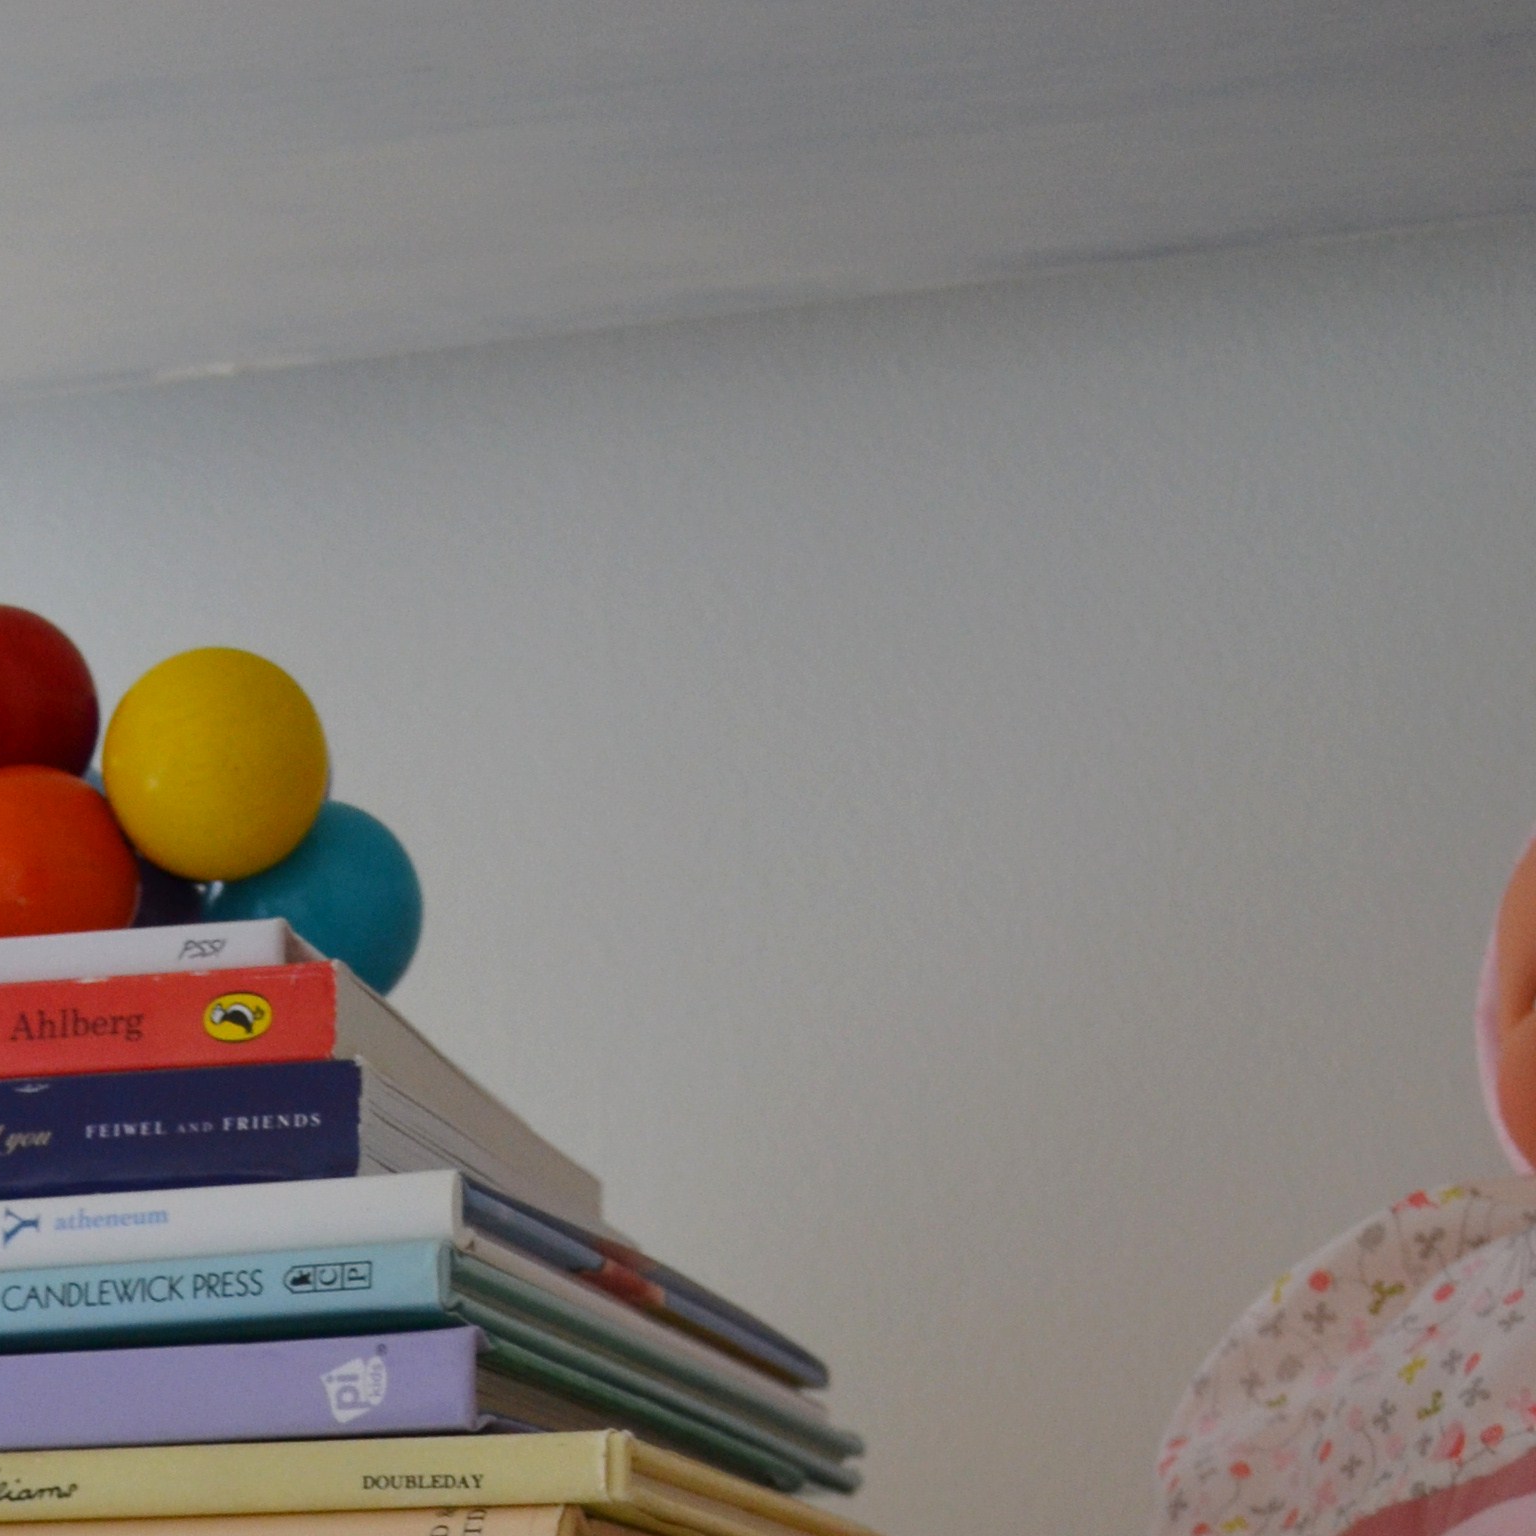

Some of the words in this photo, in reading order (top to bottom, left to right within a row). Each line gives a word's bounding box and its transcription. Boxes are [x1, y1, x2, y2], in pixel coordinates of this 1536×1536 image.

[9, 1009, 145, 1042] Ahlberg
[85, 1120, 164, 1140] FEIWEL
[176, 1121, 214, 1134] AND
[222, 1112, 322, 1132] FRIENDS
[4, 1129, 52, 1154] you
[54, 1207, 169, 1231] atheneum
[1, 1275, 183, 1313] CANDLEWICK
[192, 1269, 264, 1298] PRESS
[362, 1474, 484, 1490] DOUBLEDAY
